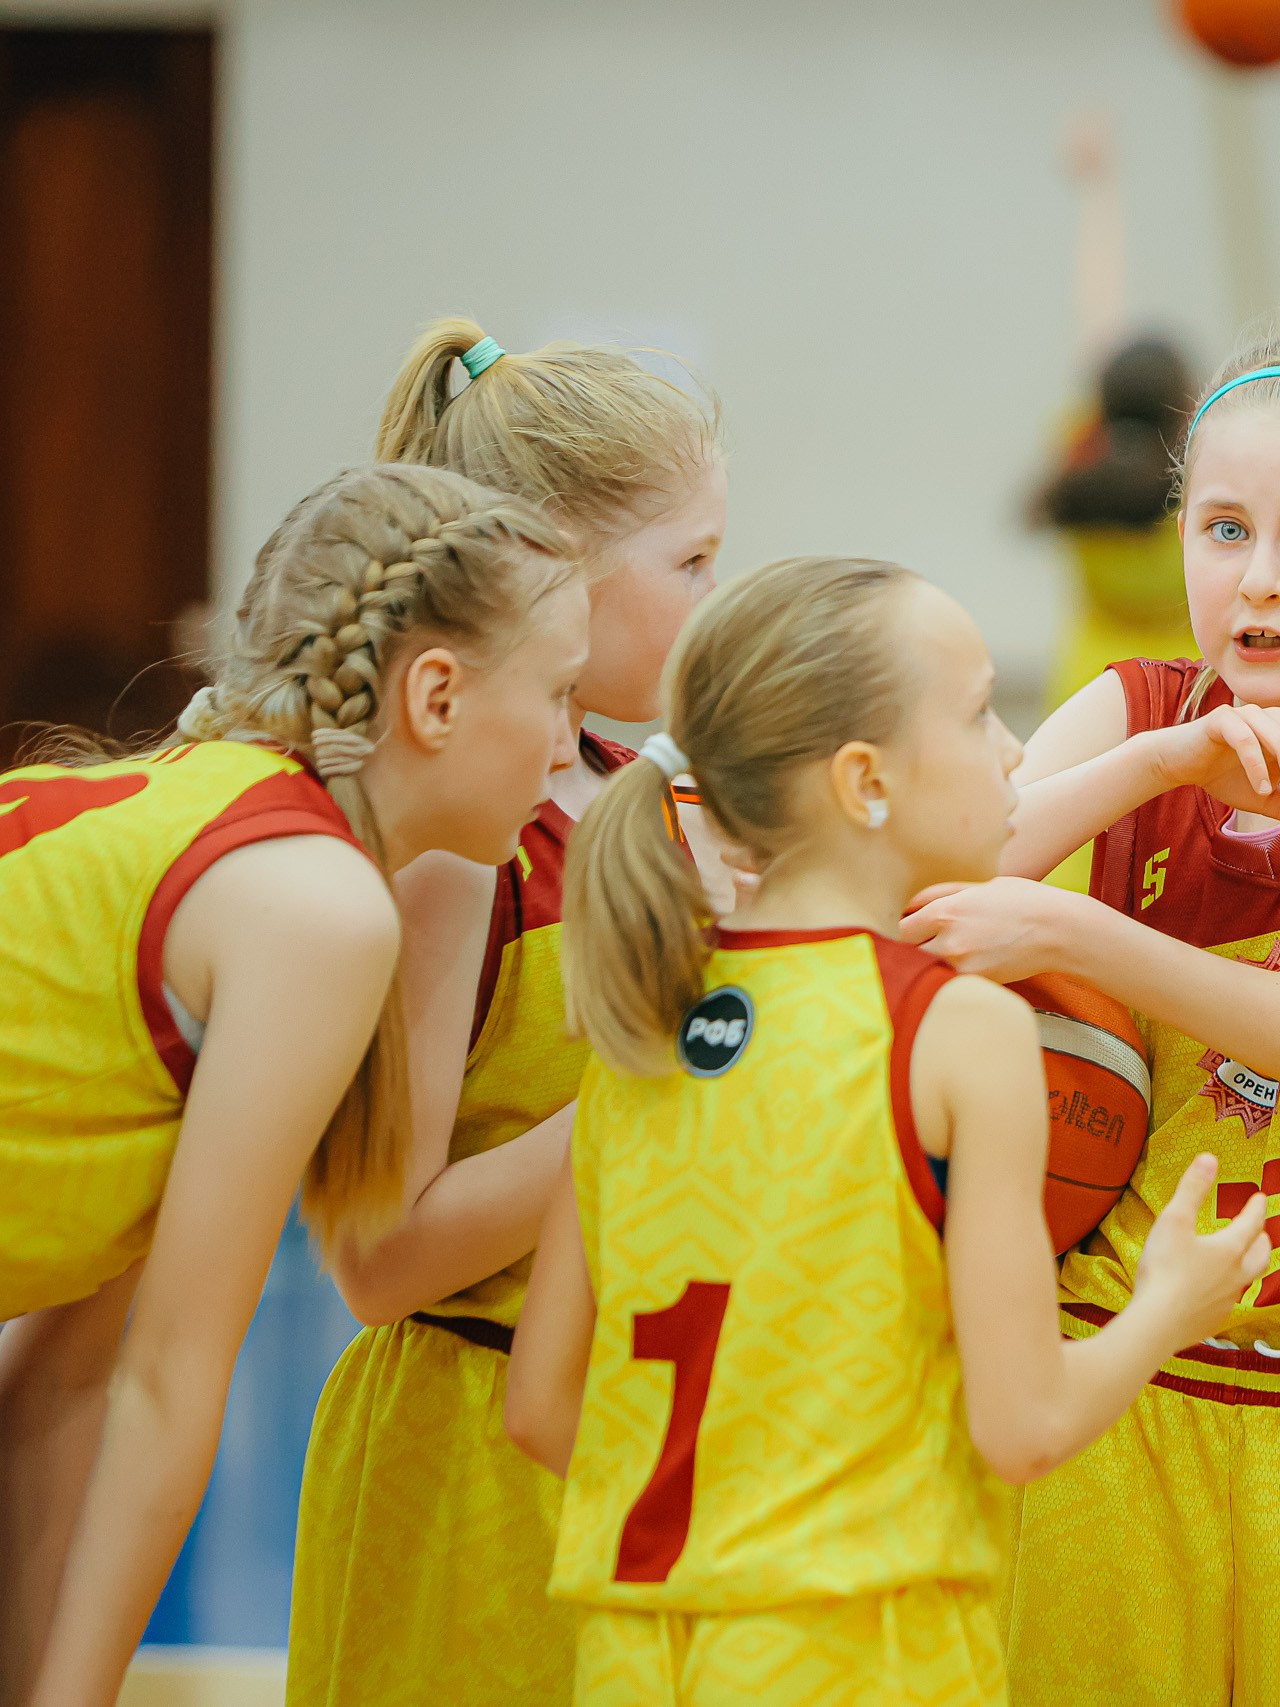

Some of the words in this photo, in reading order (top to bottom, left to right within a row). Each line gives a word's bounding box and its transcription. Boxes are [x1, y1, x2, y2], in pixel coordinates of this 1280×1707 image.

[686, 1017, 746, 1048] РФБ
[1048, 1090, 1124, 1146] olten
[613, 1280, 731, 1583] 1
